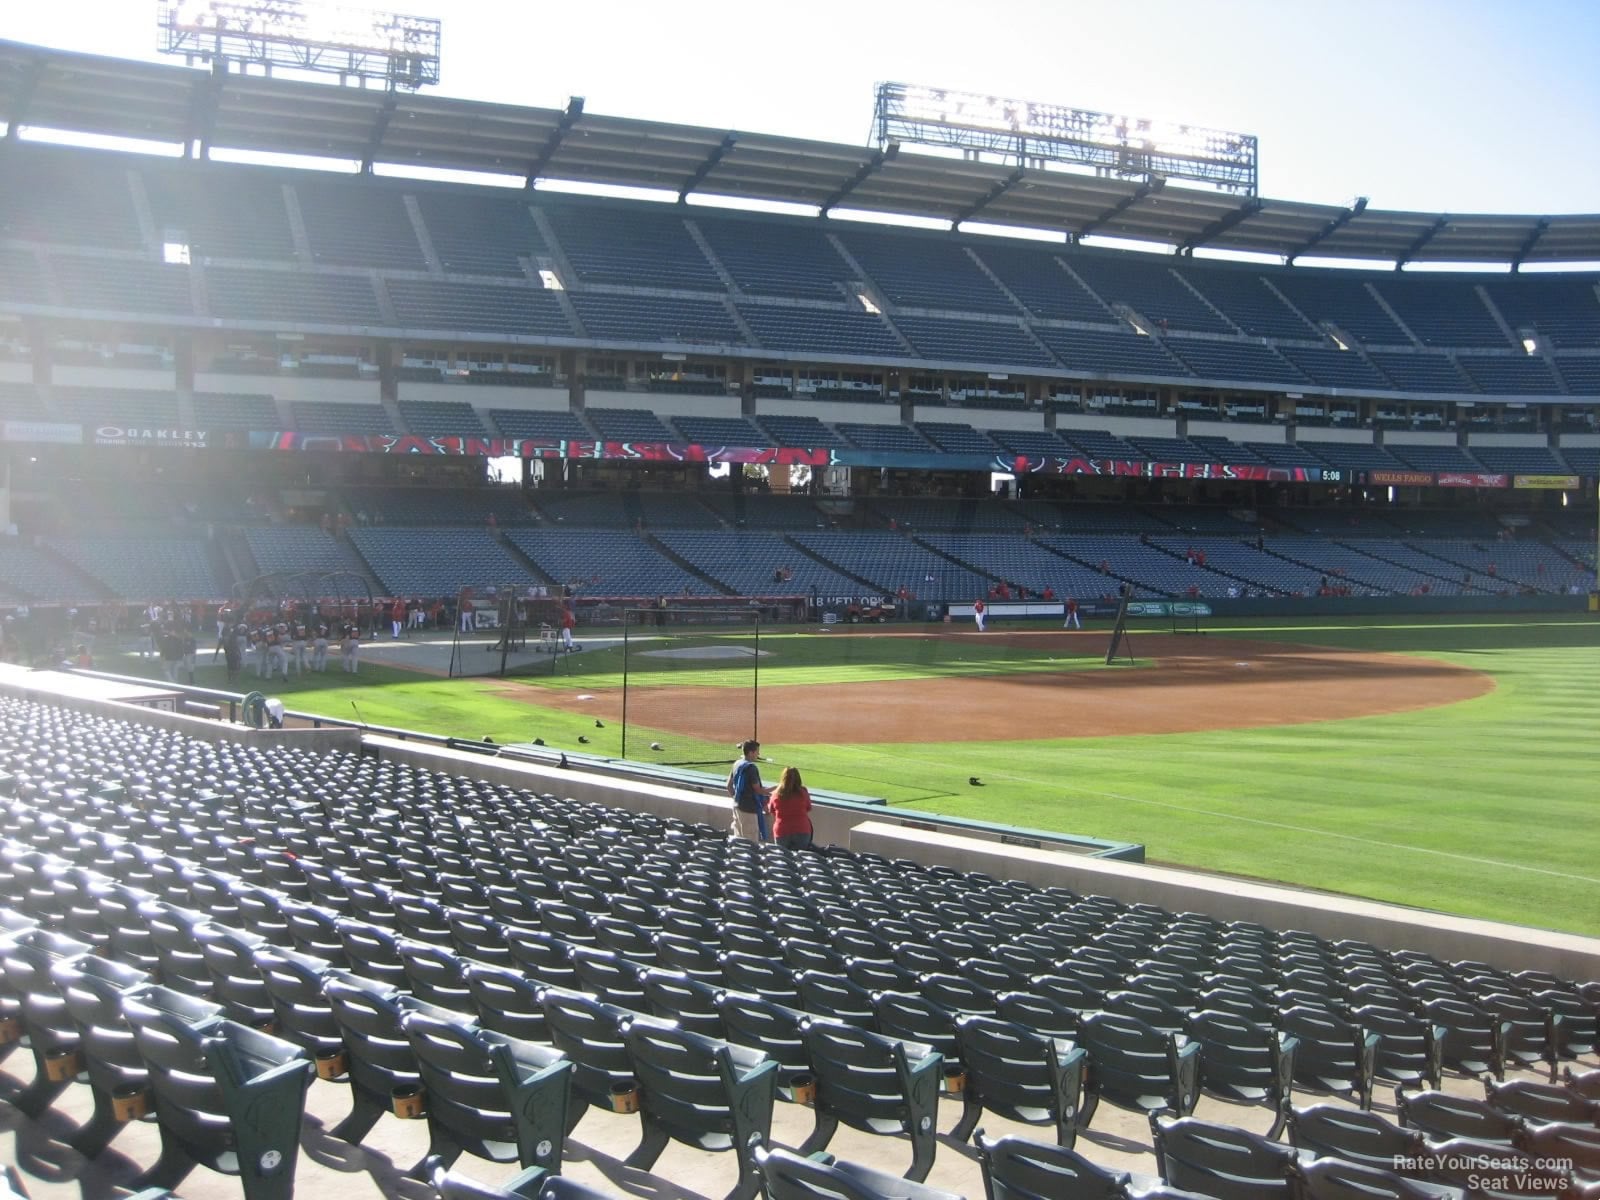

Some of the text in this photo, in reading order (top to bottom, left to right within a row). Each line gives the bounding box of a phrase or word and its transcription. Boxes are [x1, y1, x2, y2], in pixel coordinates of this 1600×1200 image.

[127, 428, 207, 440] OAKLEY
[1322, 470, 1340, 481] 5:08
[1374, 473, 1432, 483] WELLS FARGO
